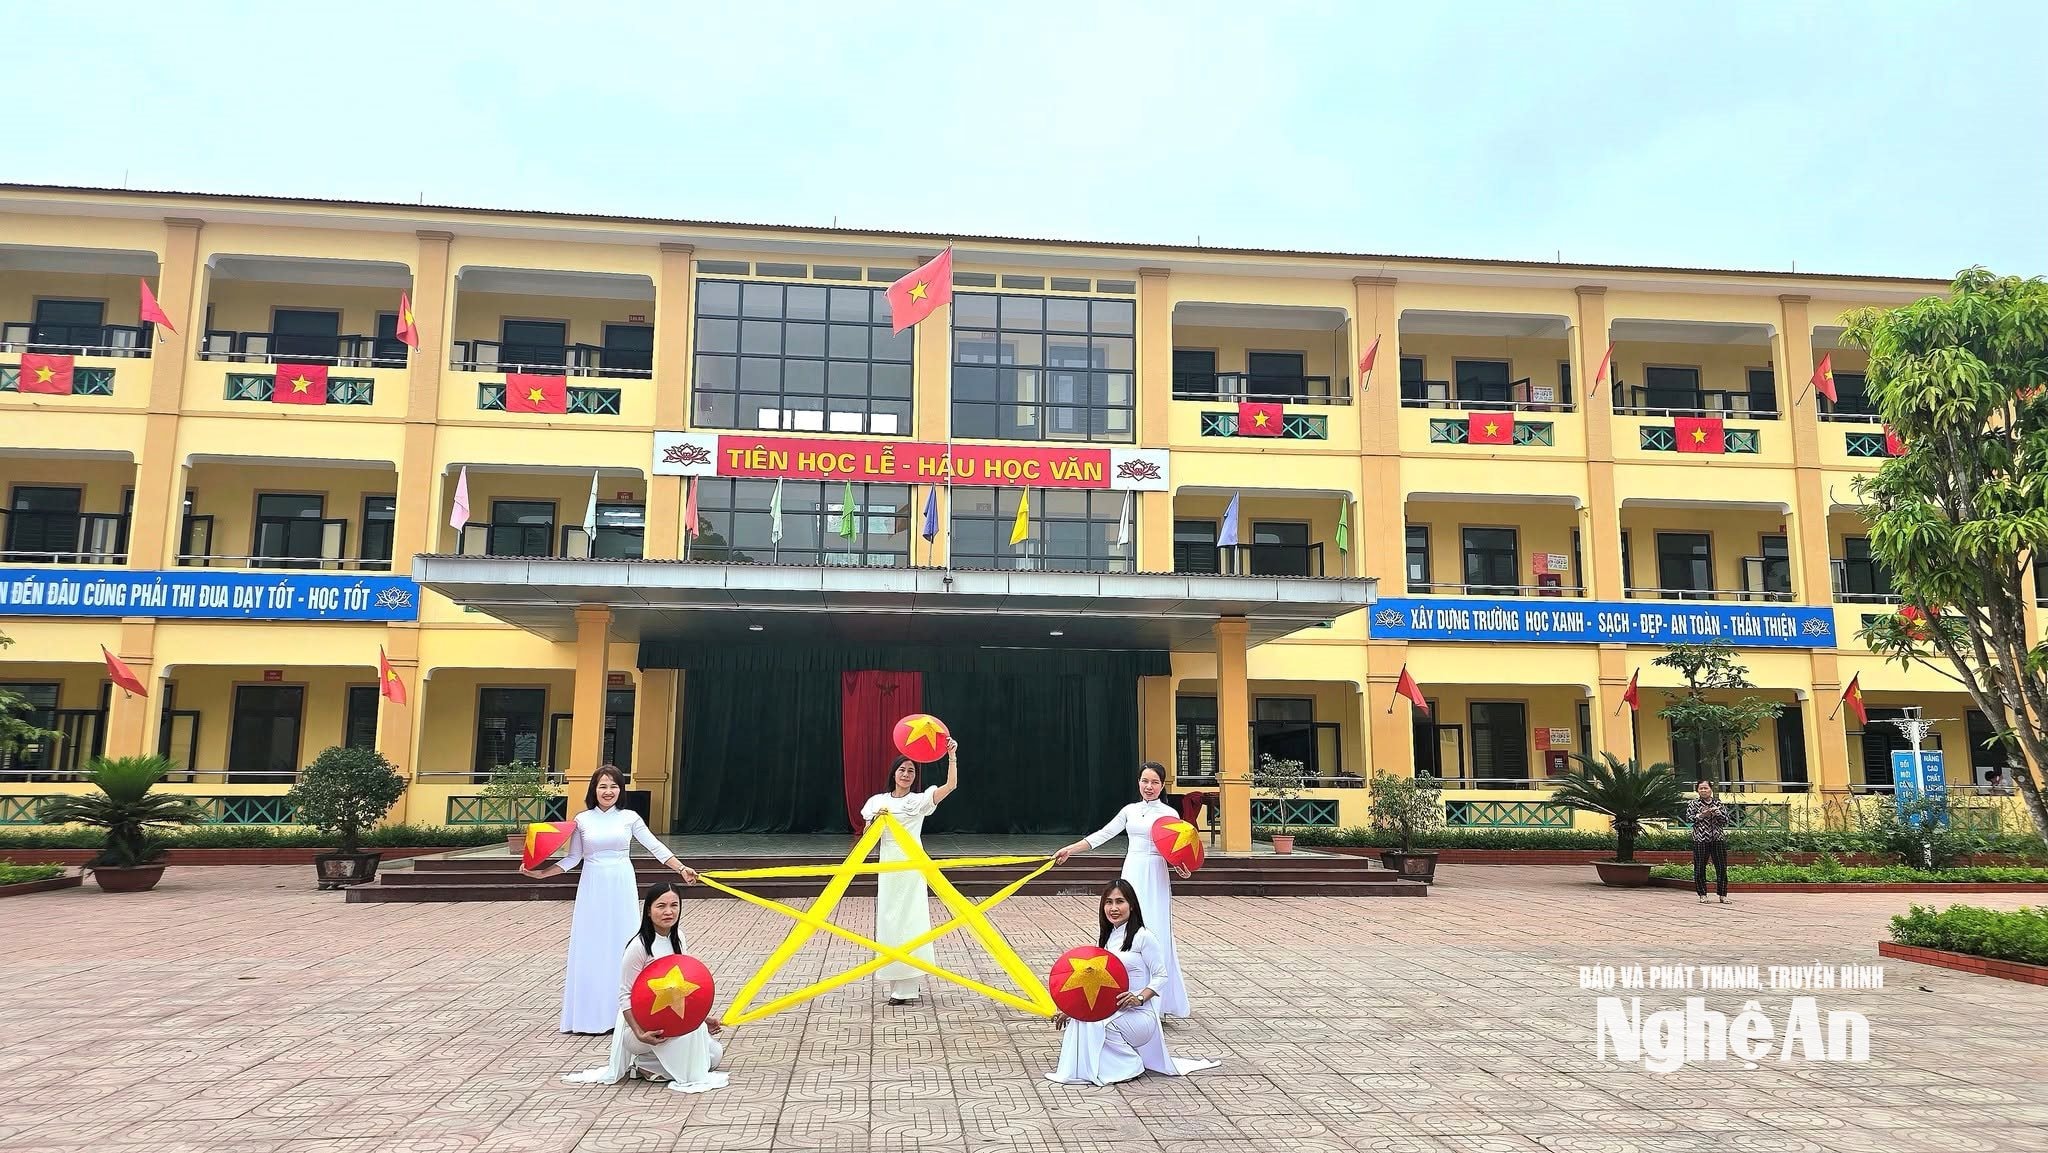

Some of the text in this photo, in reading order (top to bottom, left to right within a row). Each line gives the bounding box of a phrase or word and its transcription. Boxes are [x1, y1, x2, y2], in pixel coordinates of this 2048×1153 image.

[797, 451, 856, 477] HỌC
[864, 445, 896, 475] LỄ
[918, 453, 975, 481] HẬU
[984, 458, 1040, 484] HỌC
[1049, 456, 1103, 481] VĂN
[10, 574, 46, 605] ĐẾN
[47, 577, 81, 606] ĐÂU
[83, 579, 127, 607] CŨNG
[130, 576, 168, 607] PHẢI
[172, 584, 196, 608] THI
[199, 584, 229, 608] ĐUA
[232, 585, 265, 614] DẠY
[268, 579, 295, 609] TỐT
[307, 587, 339, 614] HỌC
[343, 580, 371, 611] TỐT
[1411, 604, 1433, 629] XÂY
[1437, 608, 1470, 634] DỰNG
[1472, 606, 1519, 631] TRƯỜNG
[1525, 611, 1549, 636] HỌC
[1552, 612, 1584, 632] XANH
[1598, 612, 1629, 637] SẠCH
[1671, 614, 1687, 634] AN
[1690, 611, 1721, 635] TOÀN
[1730, 613, 1761, 636] THÂN
[1763, 613, 1797, 641] THIỆN
